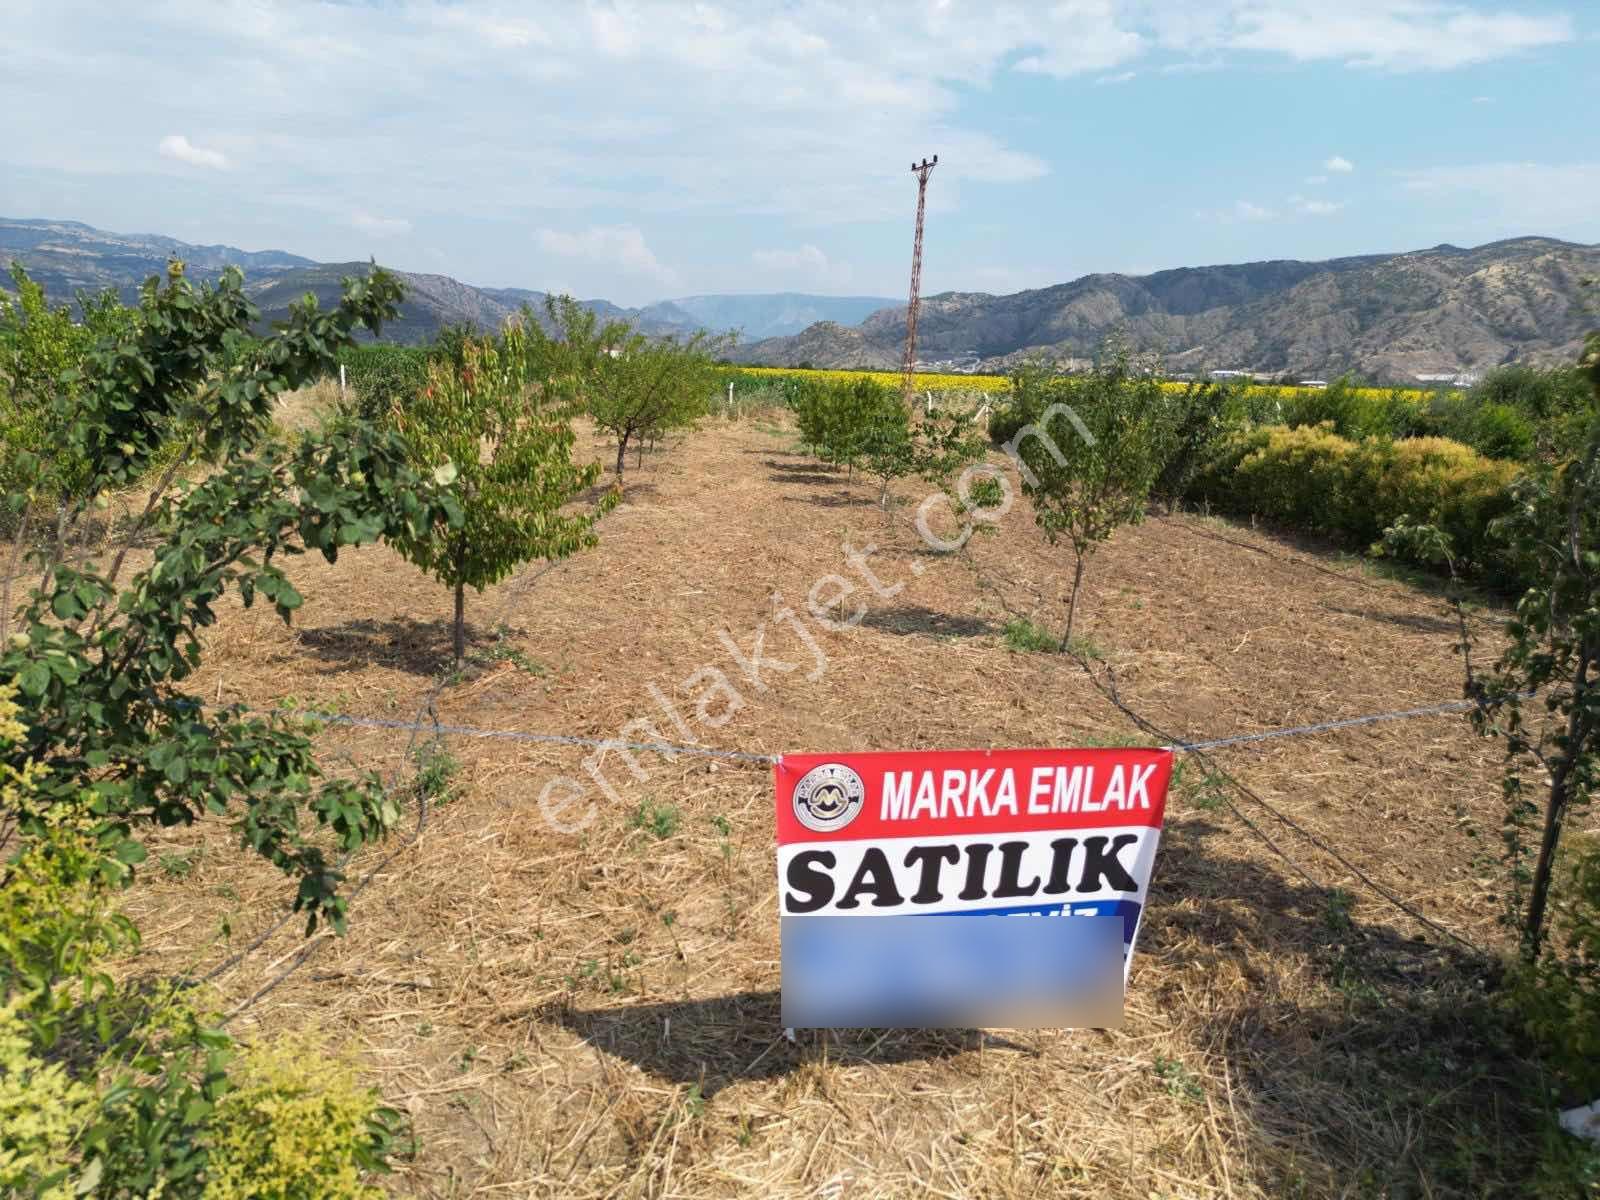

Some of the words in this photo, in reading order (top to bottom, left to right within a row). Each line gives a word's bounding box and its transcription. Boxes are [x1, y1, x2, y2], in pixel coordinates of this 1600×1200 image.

[880, 768, 1018, 820] MARKA
[1027, 764, 1156, 815] EMLAK
[786, 834, 1138, 913] SATILIK
